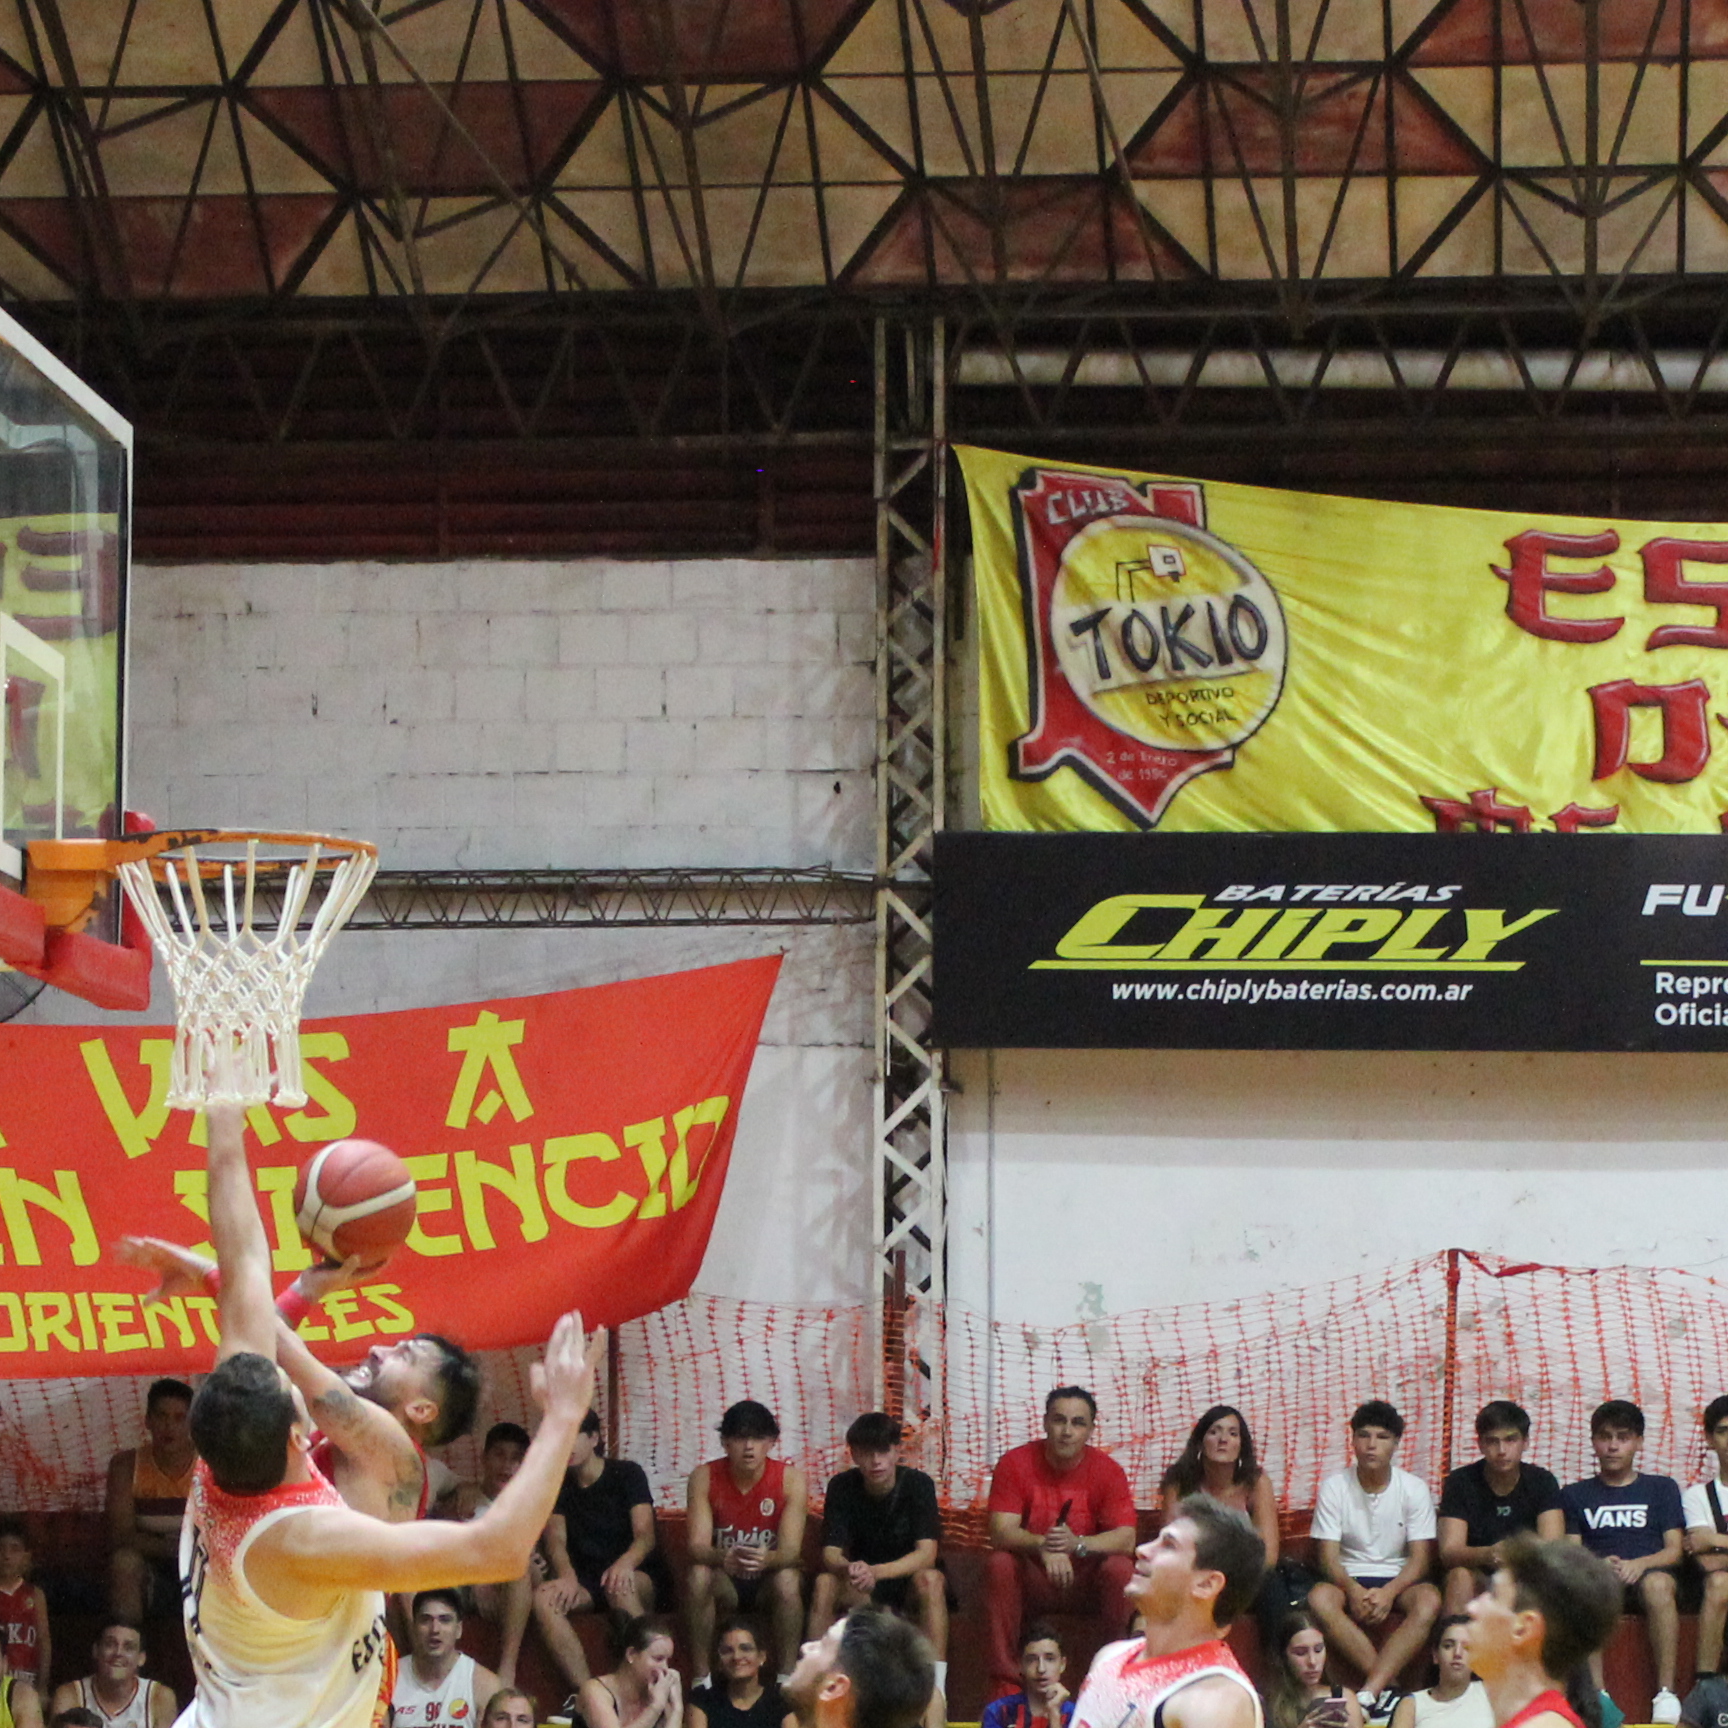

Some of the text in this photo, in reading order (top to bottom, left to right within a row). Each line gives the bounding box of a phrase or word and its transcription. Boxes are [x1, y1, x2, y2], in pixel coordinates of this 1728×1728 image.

[1069, 594, 1269, 680] TOKIO
[1146, 686, 1235, 706] DEPORTIVO
[1159, 712, 1238, 728] Y SOCIAL
[1213, 881, 1462, 903] BATERÍAS
[1053, 893, 1560, 962] CHIPLY
[1111, 978, 1473, 1004] www.chiplybaterias.com.ar
[444, 1009, 536, 1130] A
[173, 1095, 731, 1272] IENCIO
[1584, 1504, 1649, 1530] VANS
